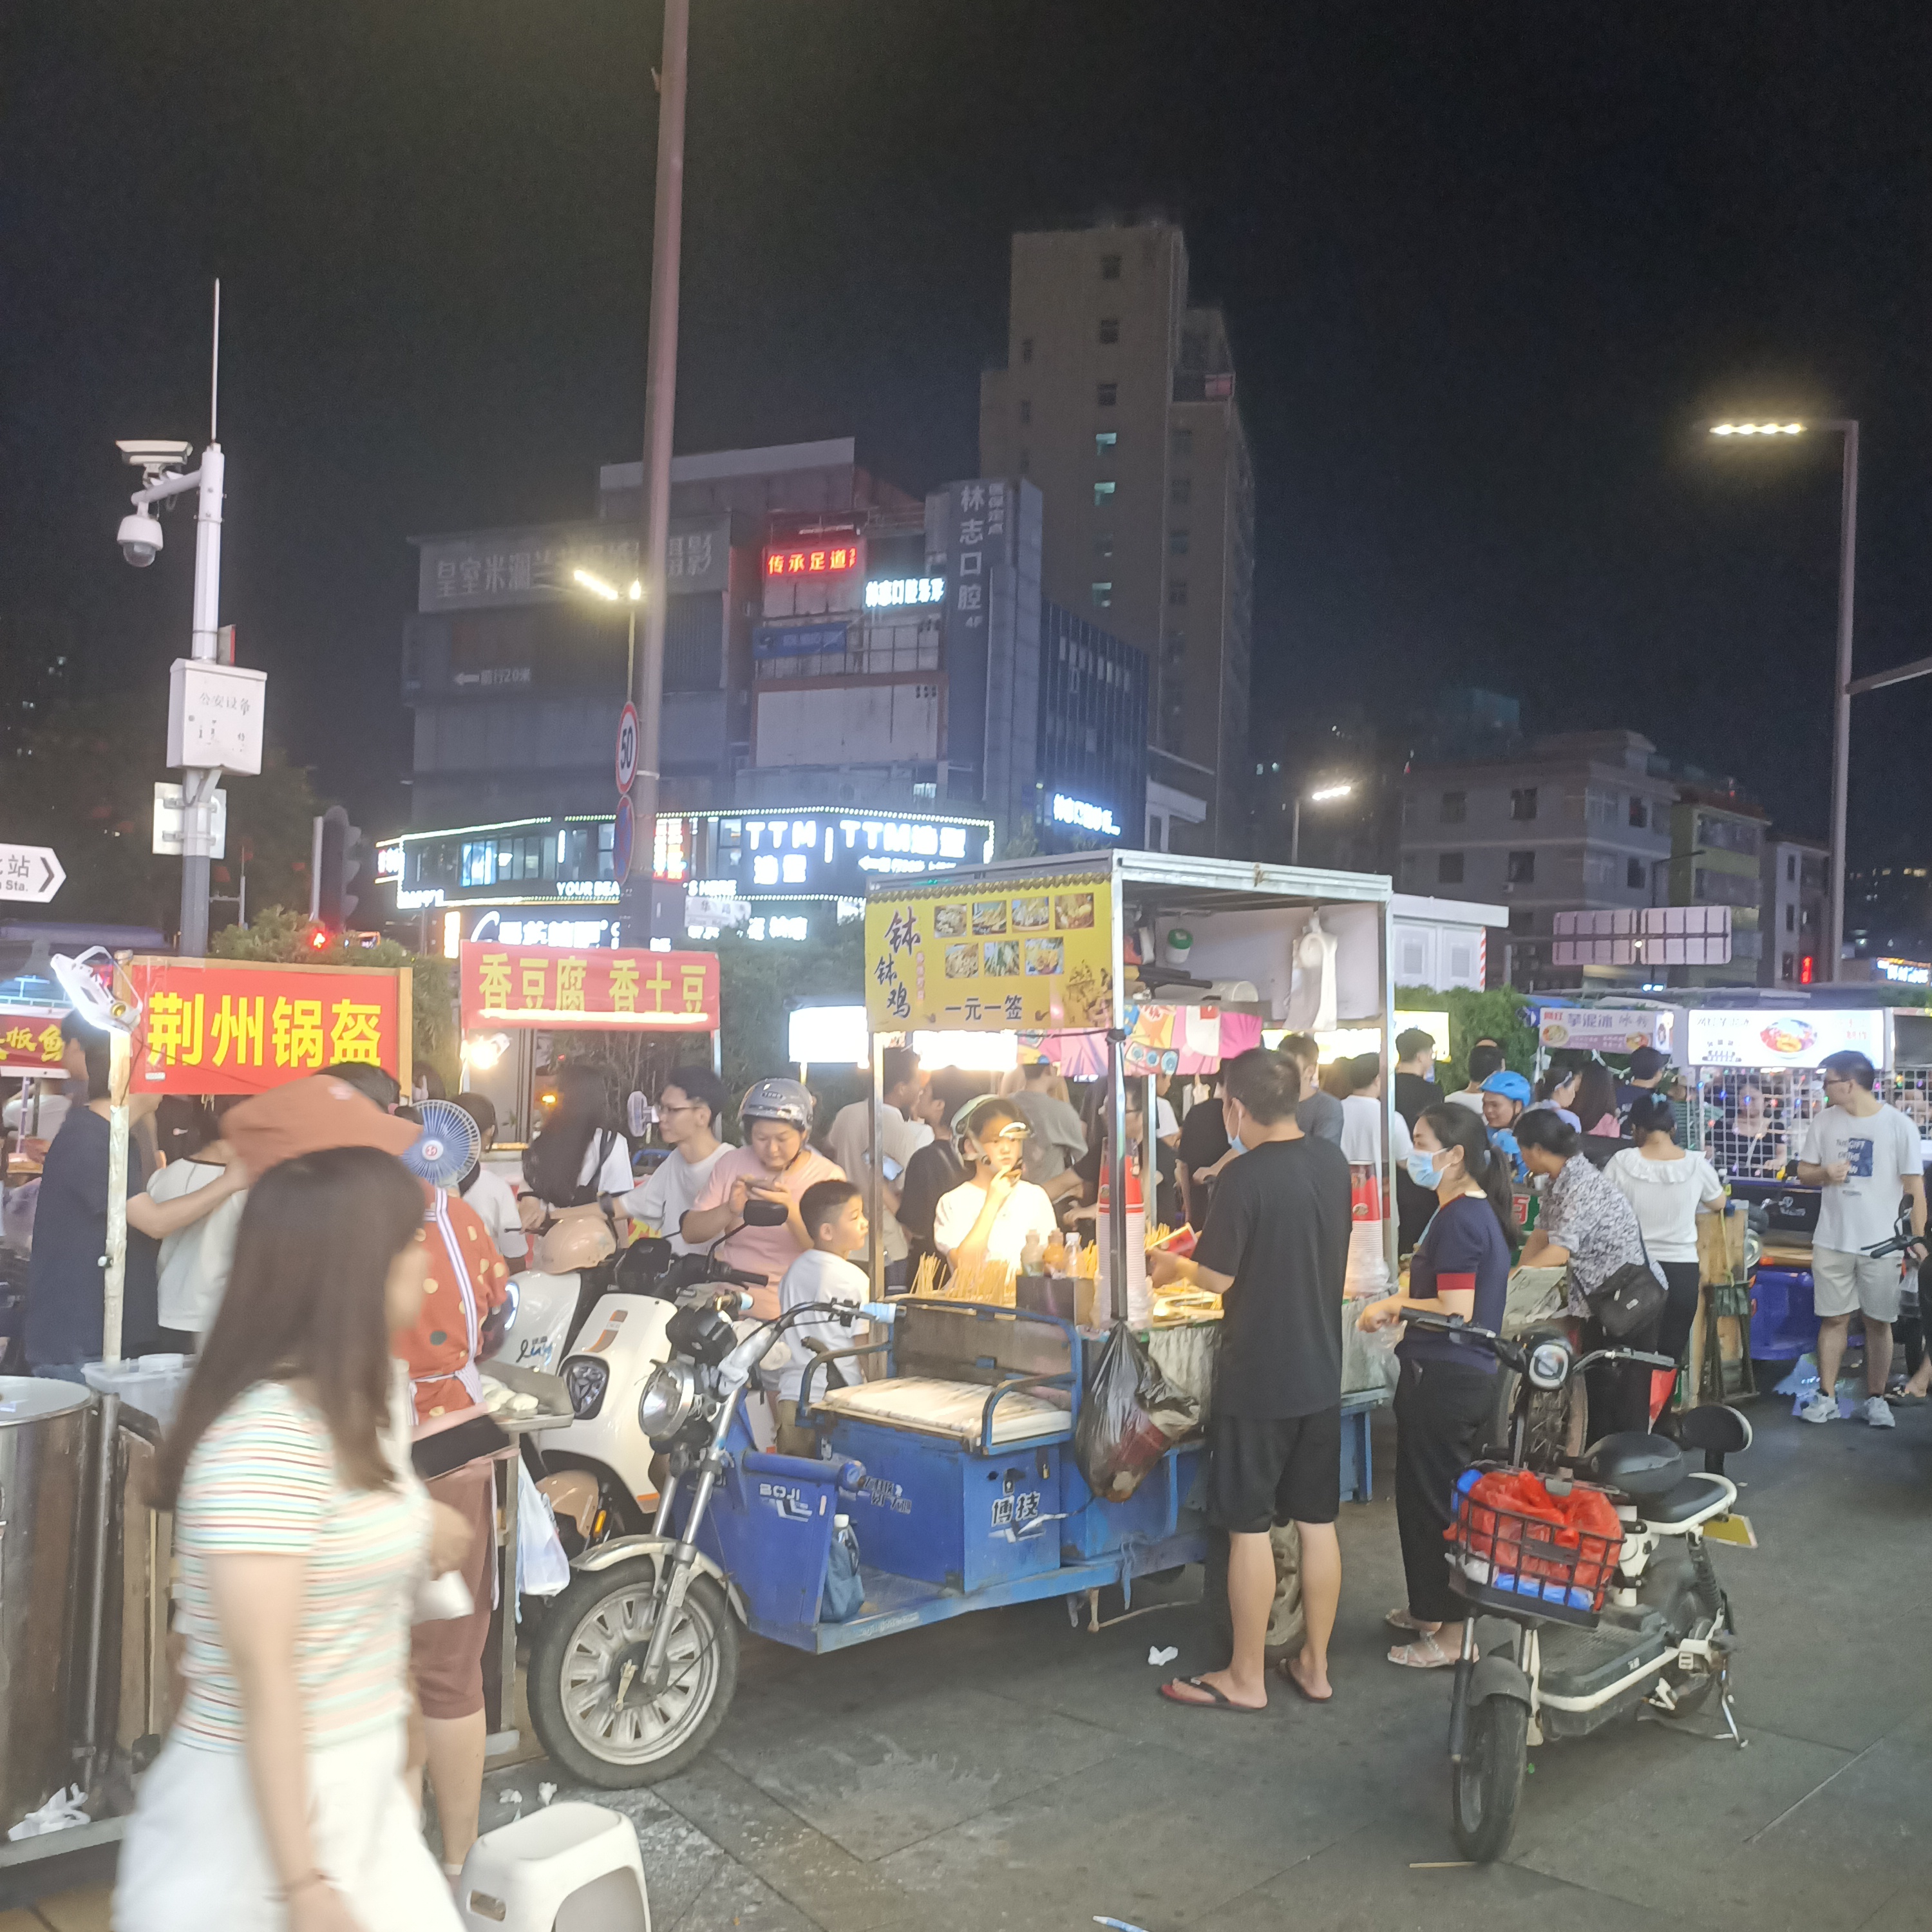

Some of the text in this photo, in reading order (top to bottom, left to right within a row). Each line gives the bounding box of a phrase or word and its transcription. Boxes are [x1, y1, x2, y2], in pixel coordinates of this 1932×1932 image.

[958, 486, 985, 611] 林志口腔
[200, 692, 251, 715] 公安设备
[621, 726, 633, 769] 50
[745, 820, 817, 850] TTM
[0, 854, 30, 877] 站
[6, 880, 28, 891] Sta.
[556, 882, 593, 896] YOUR
[873, 905, 921, 1019] 钵钵鸡
[478, 952, 706, 1014] 香豆腐 香土豆
[945, 994, 1023, 1022] 一元一签
[0, 1024, 62, 1062] 板鱼
[147, 991, 381, 1068] 荆州锅盔
[759, 1483, 800, 1501] BOJI
[992, 1491, 1040, 1527] 博技
